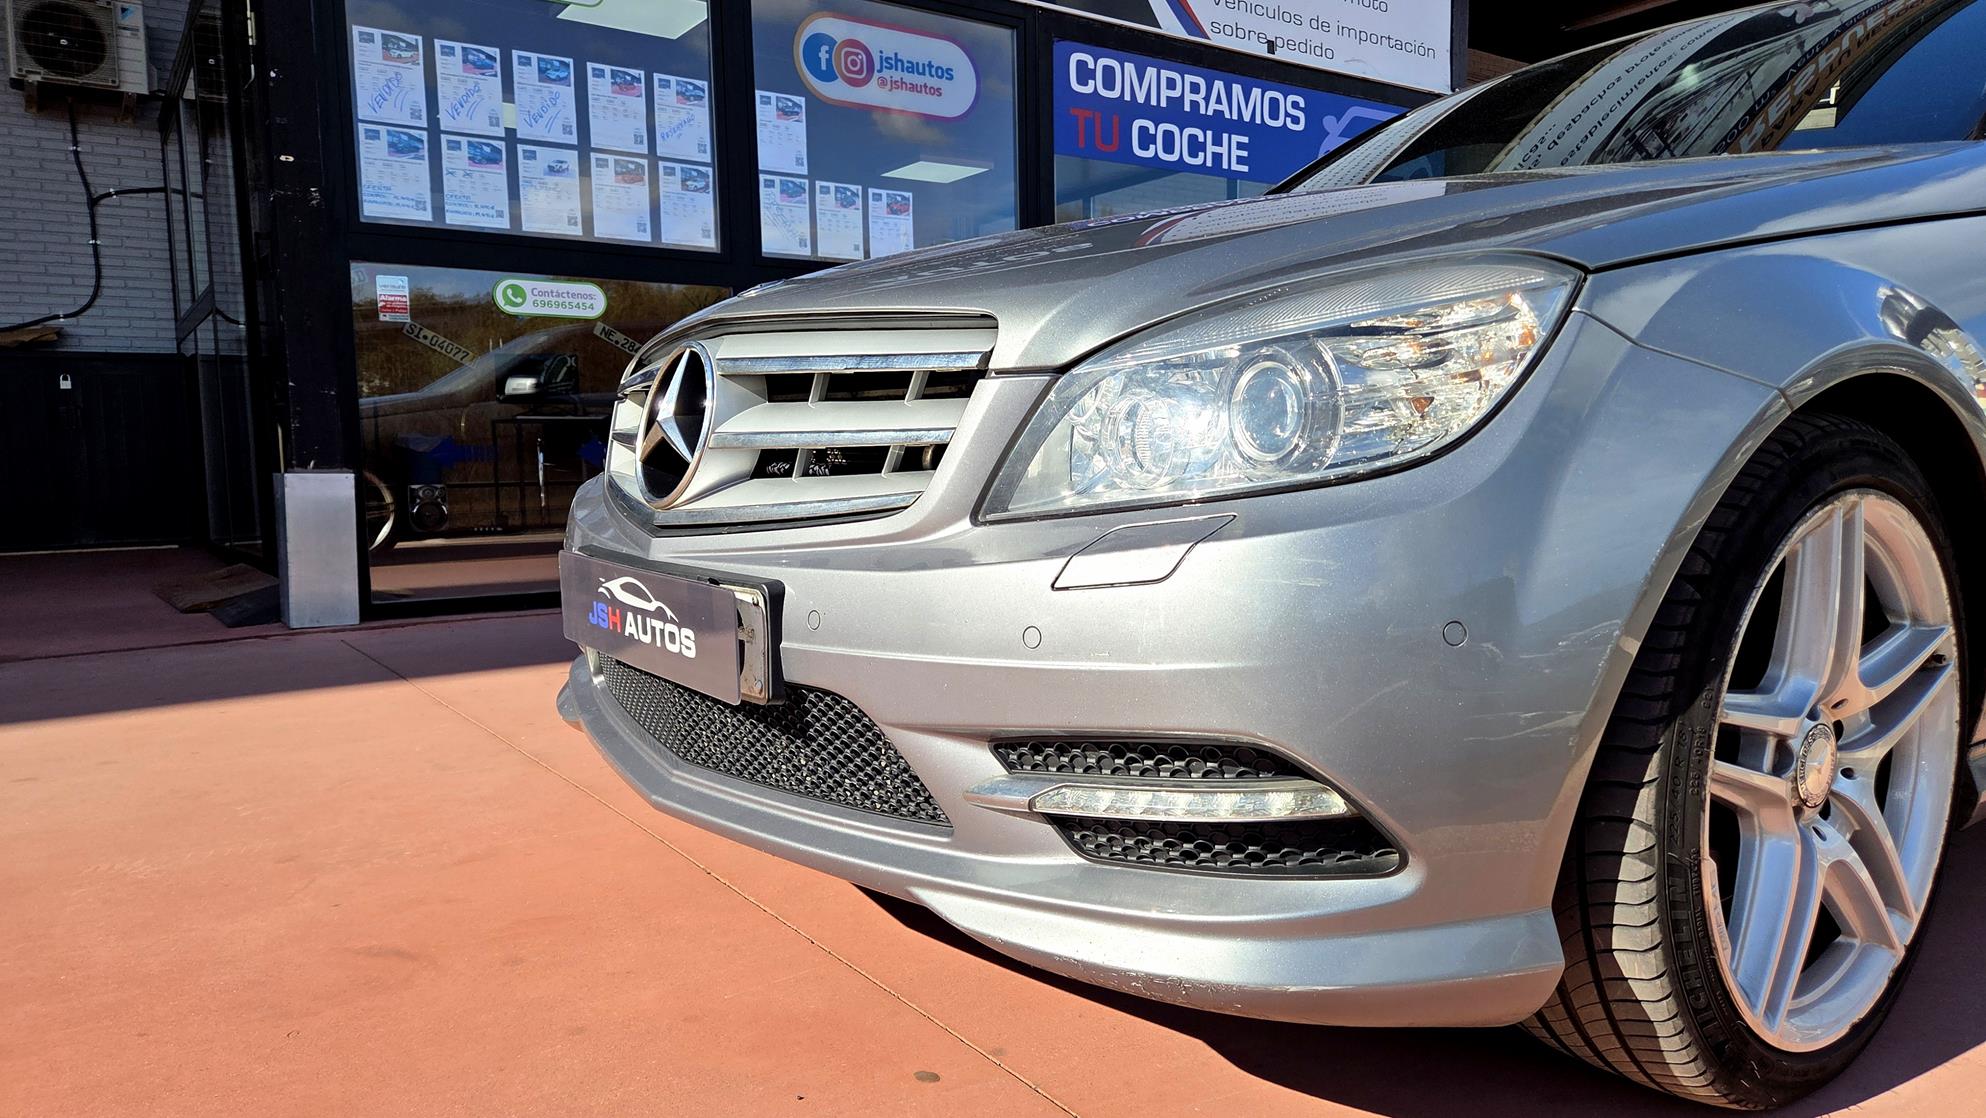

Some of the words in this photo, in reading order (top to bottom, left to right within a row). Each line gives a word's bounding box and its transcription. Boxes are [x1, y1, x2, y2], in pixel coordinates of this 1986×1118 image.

[1344, 0, 1388, 13] oto
[1210, 21, 1268, 45] sobre
[1274, 35, 1335, 60] pedido
[1309, 15, 1331, 33] de
[1337, 20, 1436, 60] importación
[876, 50, 954, 81] jshautos
[445, 83, 481, 121] VENDIDO
[524, 91, 560, 128] VENDIDO
[1068, 52, 1306, 131] COMPRAMOS
[1069, 107, 1120, 152] TU
[1131, 119, 1249, 173] COCHE
[531, 287, 597, 301] Contáctenos:
[532, 300, 595, 311] 696965454
[588, 600, 622, 633] JSH
[624, 611, 697, 659] AUTOS
